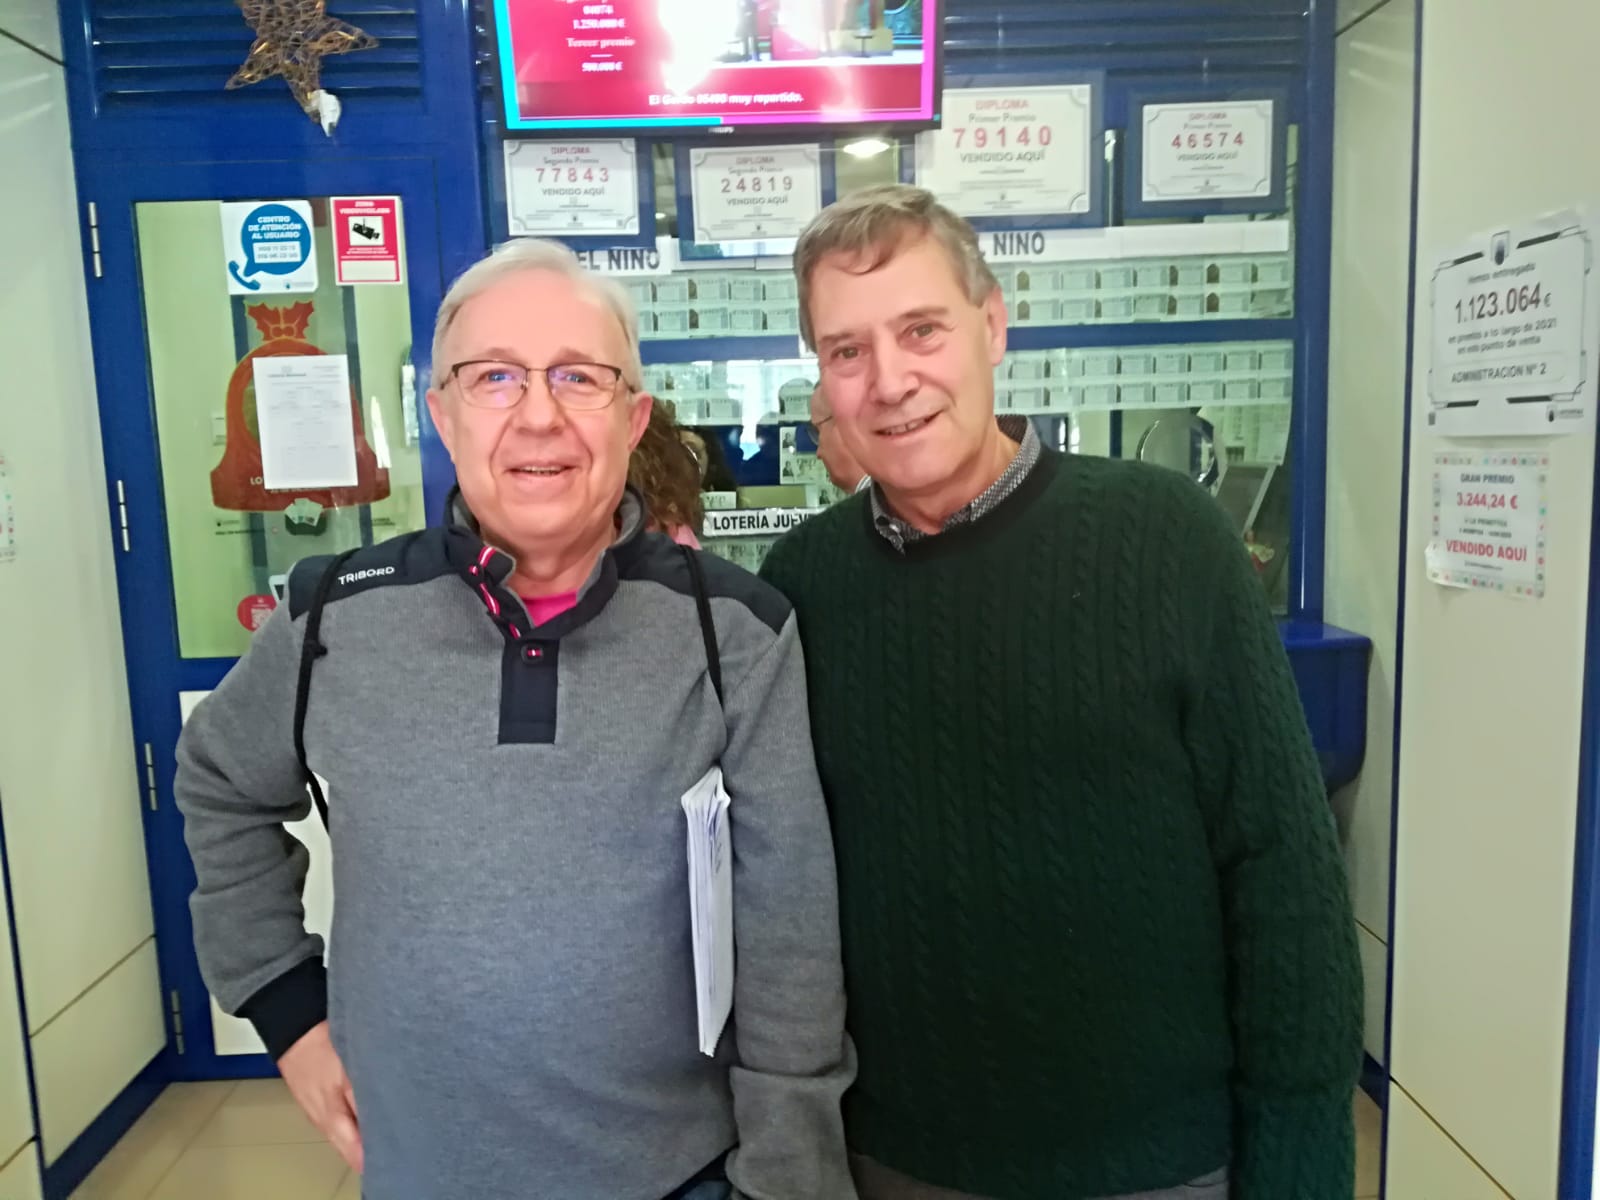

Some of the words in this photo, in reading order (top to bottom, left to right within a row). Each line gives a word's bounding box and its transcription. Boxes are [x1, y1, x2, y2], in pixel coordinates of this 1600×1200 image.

[566, 38, 598, 48] Tercer
[600, 36, 635, 48] premio
[729, 94, 752, 106] muy
[976, 100, 1029, 110] DIPLOMA
[1003, 113, 1036, 122] Premio
[953, 126, 1052, 148] 79140
[1172, 132, 1244, 148] 46574
[736, 156, 774, 164] DIPLOMA
[960, 152, 1014, 163] VENDIDO
[536, 168, 608, 182] 77843
[721, 176, 792, 193] 24819
[542, 188, 581, 196] VENDIDO
[726, 197, 766, 206] VENDIDO
[258, 216, 290, 224] CENTRO
[248, 224, 259, 232] DE
[252, 232, 262, 240] AL
[1535, 318, 1556, 330] 2021
[1540, 362, 1546, 375] 2
[250, 476, 262, 485] LO
[1460, 474, 1480, 482] GRAN
[1483, 474, 1514, 484] PREMIO
[1510, 495, 1518, 509] €
[714, 512, 769, 530] LOTERÍA
[774, 513, 808, 528] JUEV
[1446, 540, 1494, 557] VENDIDO
[338, 566, 394, 586] TRIBORD
